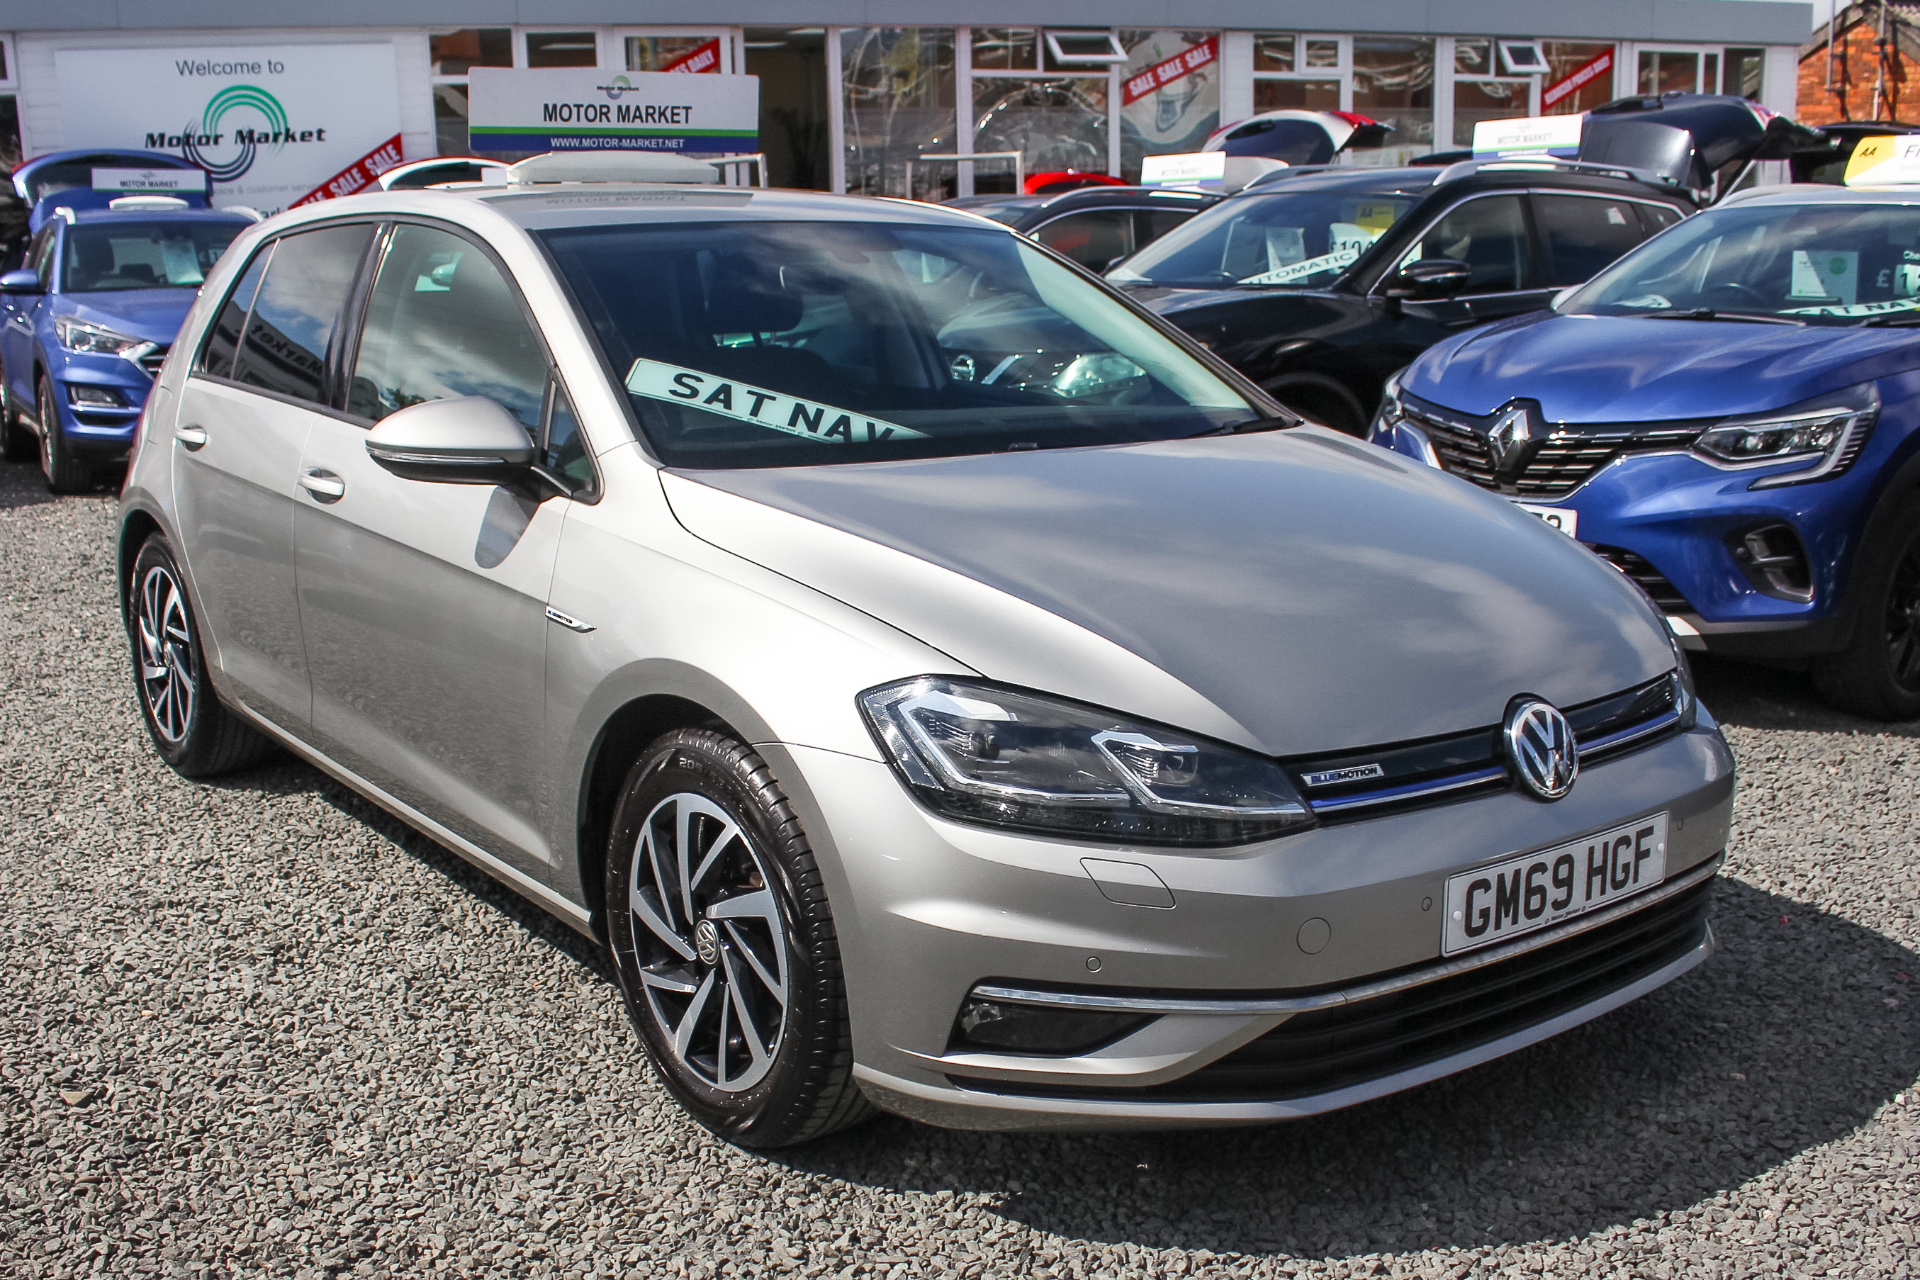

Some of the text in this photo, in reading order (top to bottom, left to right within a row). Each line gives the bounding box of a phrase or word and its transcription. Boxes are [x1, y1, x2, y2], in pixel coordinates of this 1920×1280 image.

[175, 58, 284, 76] Welcome to
[1128, 44, 1212, 96] SALE SALE SALE
[543, 103, 692, 124] MOTOR MARKET
[144, 127, 326, 149] Motor Market
[550, 138, 685, 148] WWW.MOTOR-MARKET.NET
[1859, 146, 1878, 158] AA
[328, 144, 401, 198] SALE SALE
[668, 372, 895, 443] SAT NAV
[1310, 766, 1378, 784] BLUEMOTION
[1464, 825, 1654, 938] GM69 HGF
